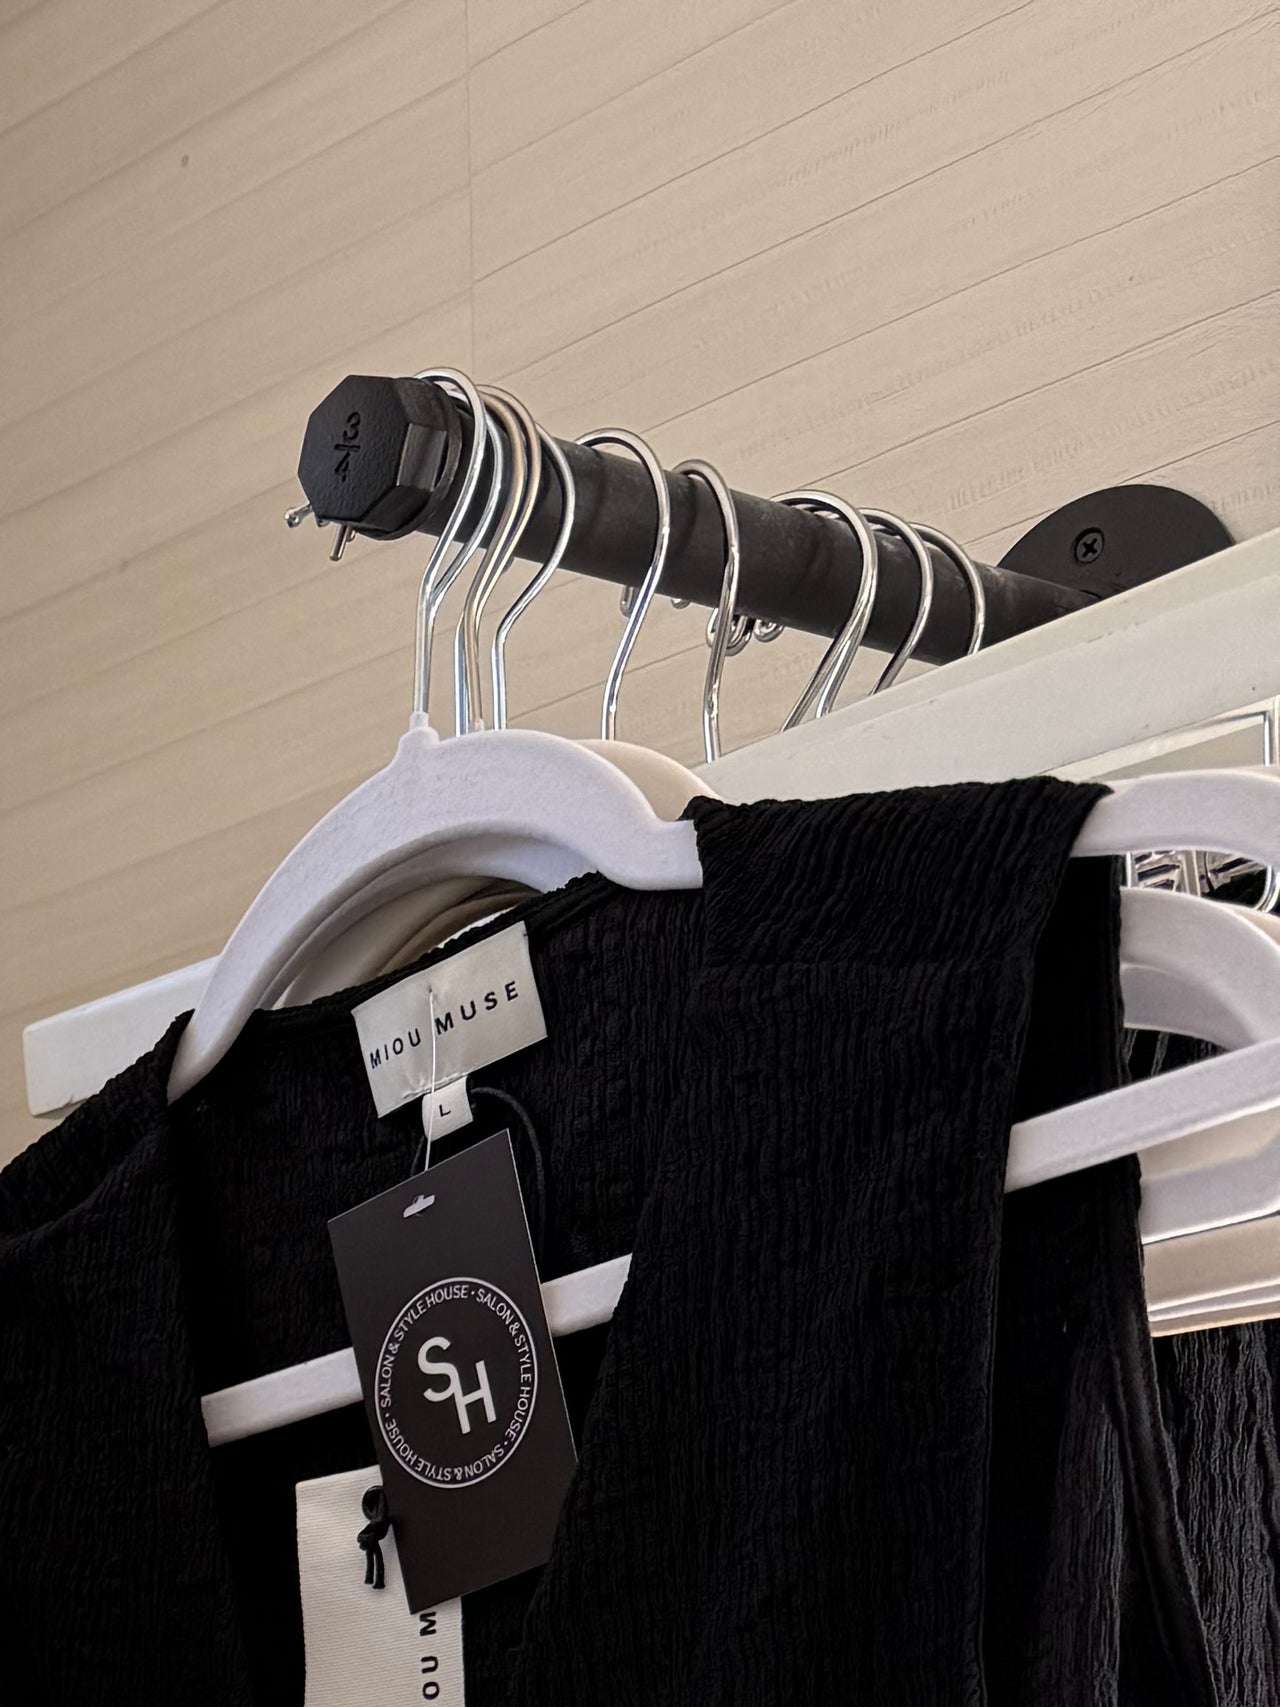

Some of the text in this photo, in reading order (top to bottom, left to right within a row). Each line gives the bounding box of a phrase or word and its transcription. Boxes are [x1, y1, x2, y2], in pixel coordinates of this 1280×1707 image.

[369, 980, 520, 1069] MIOU MUSE
[438, 1104, 452, 1118] L
[380, 1284, 470, 1409] SALON & STYLE HOUSE
[417, 1336, 497, 1435] SH
[475, 1288, 532, 1441] SALON & STYLE HOUSE
[384, 1418, 505, 1481] SALON & STYLE HOUSE
